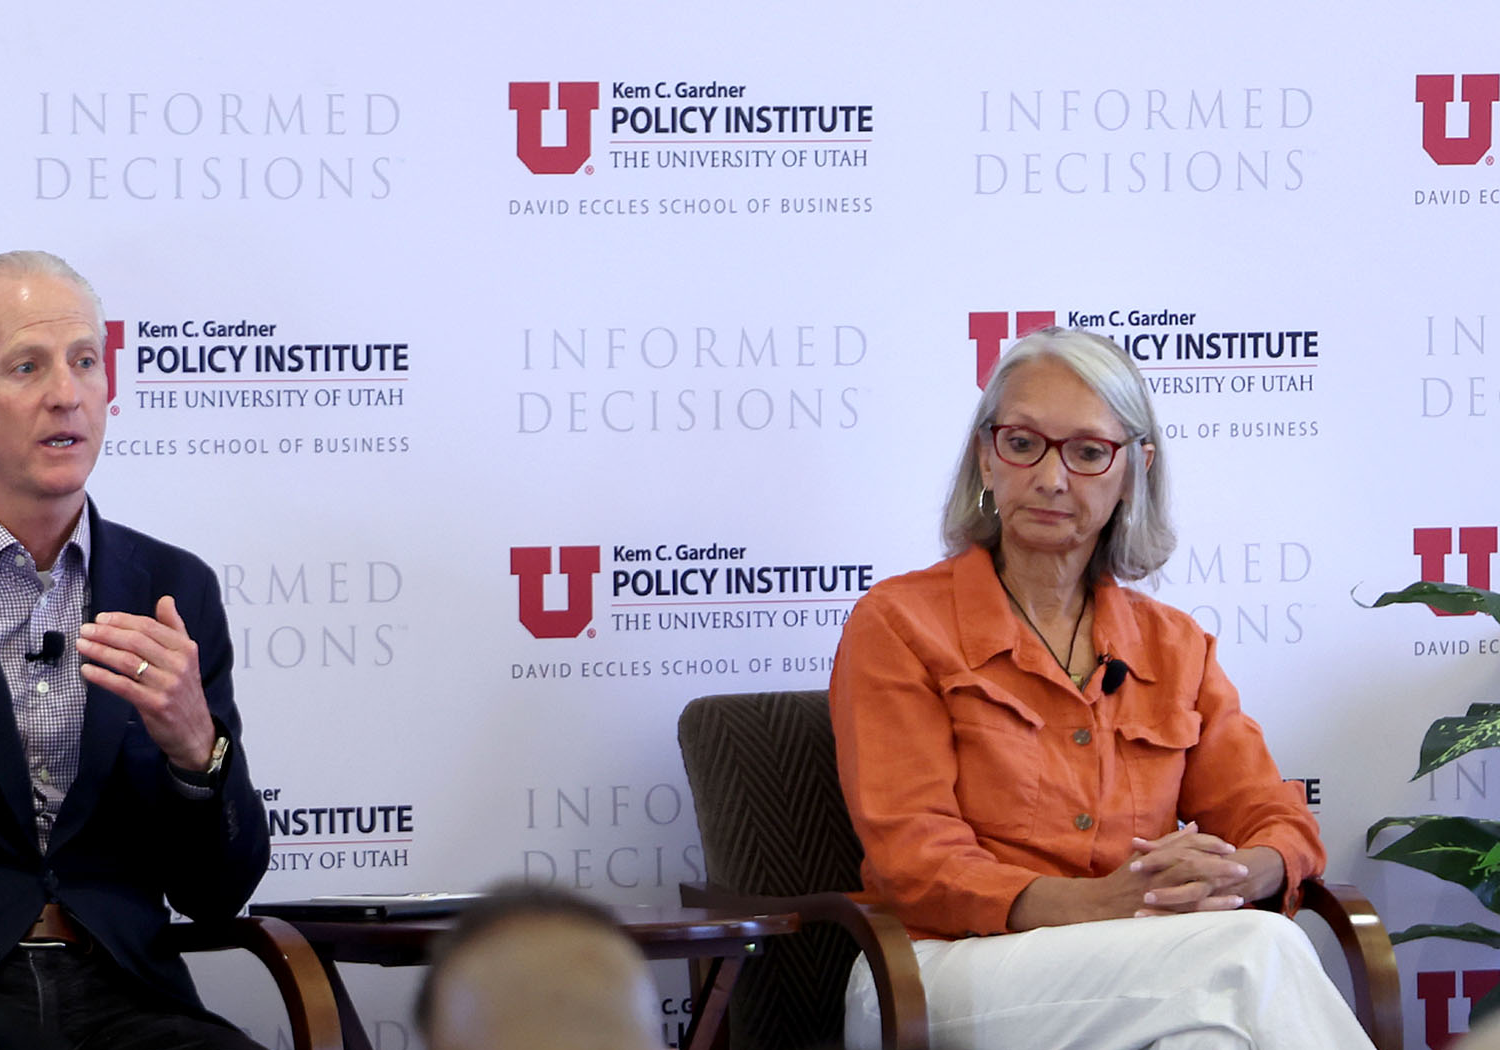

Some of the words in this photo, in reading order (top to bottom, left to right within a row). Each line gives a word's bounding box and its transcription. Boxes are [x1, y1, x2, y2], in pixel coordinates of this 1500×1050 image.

[612, 80, 651, 100] Kem
[654, 80, 672, 99] C.
[674, 79, 747, 99] Gardner
[39, 92, 401, 136] INFORMED
[611, 105, 718, 135] POLICY
[725, 104, 873, 134] INSTITUTE
[979, 87, 1314, 133] INFORMED
[1415, 73, 1500, 166] U
[508, 81, 600, 175] U
[609, 149, 650, 169] THE
[657, 149, 777, 169] UNIVERSITY
[781, 149, 808, 169] OF
[813, 148, 868, 169] UTAH
[974, 148, 1304, 196] DECISIONS
[35, 156, 391, 201] DECISIONS
[508, 198, 570, 216] DAVID
[578, 198, 650, 216] ECCLES
[658, 197, 738, 216] SCHOOL
[746, 196, 771, 215] OF
[780, 196, 873, 214] BUSINESS
[1414, 188, 1471, 206] DAVID
[138, 320, 178, 339] Kem
[181, 319, 200, 339] C.
[202, 318, 277, 339] Gardner
[1068, 310, 1105, 328] Kem
[1108, 309, 1125, 328] C.
[1127, 308, 1197, 328] Gardner
[137, 344, 248, 375] POLICY
[255, 343, 409, 374] INSTITUTE
[522, 324, 868, 371] INFORMED
[1176, 331, 1319, 360] INSTITUTE
[135, 389, 178, 410] THE
[184, 388, 309, 410] UNIVERSITY
[313, 388, 341, 408] OF
[347, 387, 404, 408] UTAH
[1148, 375, 1226, 394] VERSITY
[1231, 375, 1255, 393] OF
[1262, 374, 1314, 392] UTAH
[516, 386, 859, 435] DECISIONS
[1197, 422, 1220, 438] OF
[1230, 420, 1319, 438] BUSINESS
[104, 438, 178, 457] ECCLES
[187, 437, 270, 456] SCHOOL
[278, 437, 304, 455] OF
[313, 436, 410, 455] BUSINESS
[613, 544, 652, 563] Kem
[654, 543, 673, 563] C.
[675, 543, 747, 562] Gardner
[222, 561, 404, 606] RMED
[510, 545, 601, 639] U
[612, 568, 719, 598] POLICY
[726, 564, 874, 596] INSTITUTE
[611, 612, 651, 632] THE
[658, 609, 777, 631] UNIVERSITY
[782, 609, 809, 628] OF
[1414, 639, 1470, 657] DAVID
[511, 661, 572, 680] DAVID
[581, 659, 652, 679] ECCLES
[660, 657, 740, 677] SCHOOL
[748, 657, 772, 675] OF
[269, 805, 414, 836] NSTITUTE
[525, 783, 682, 830] INFO
[319, 850, 346, 871] OF
[352, 848, 408, 869] UTAH
[522, 844, 701, 889] DECIS
